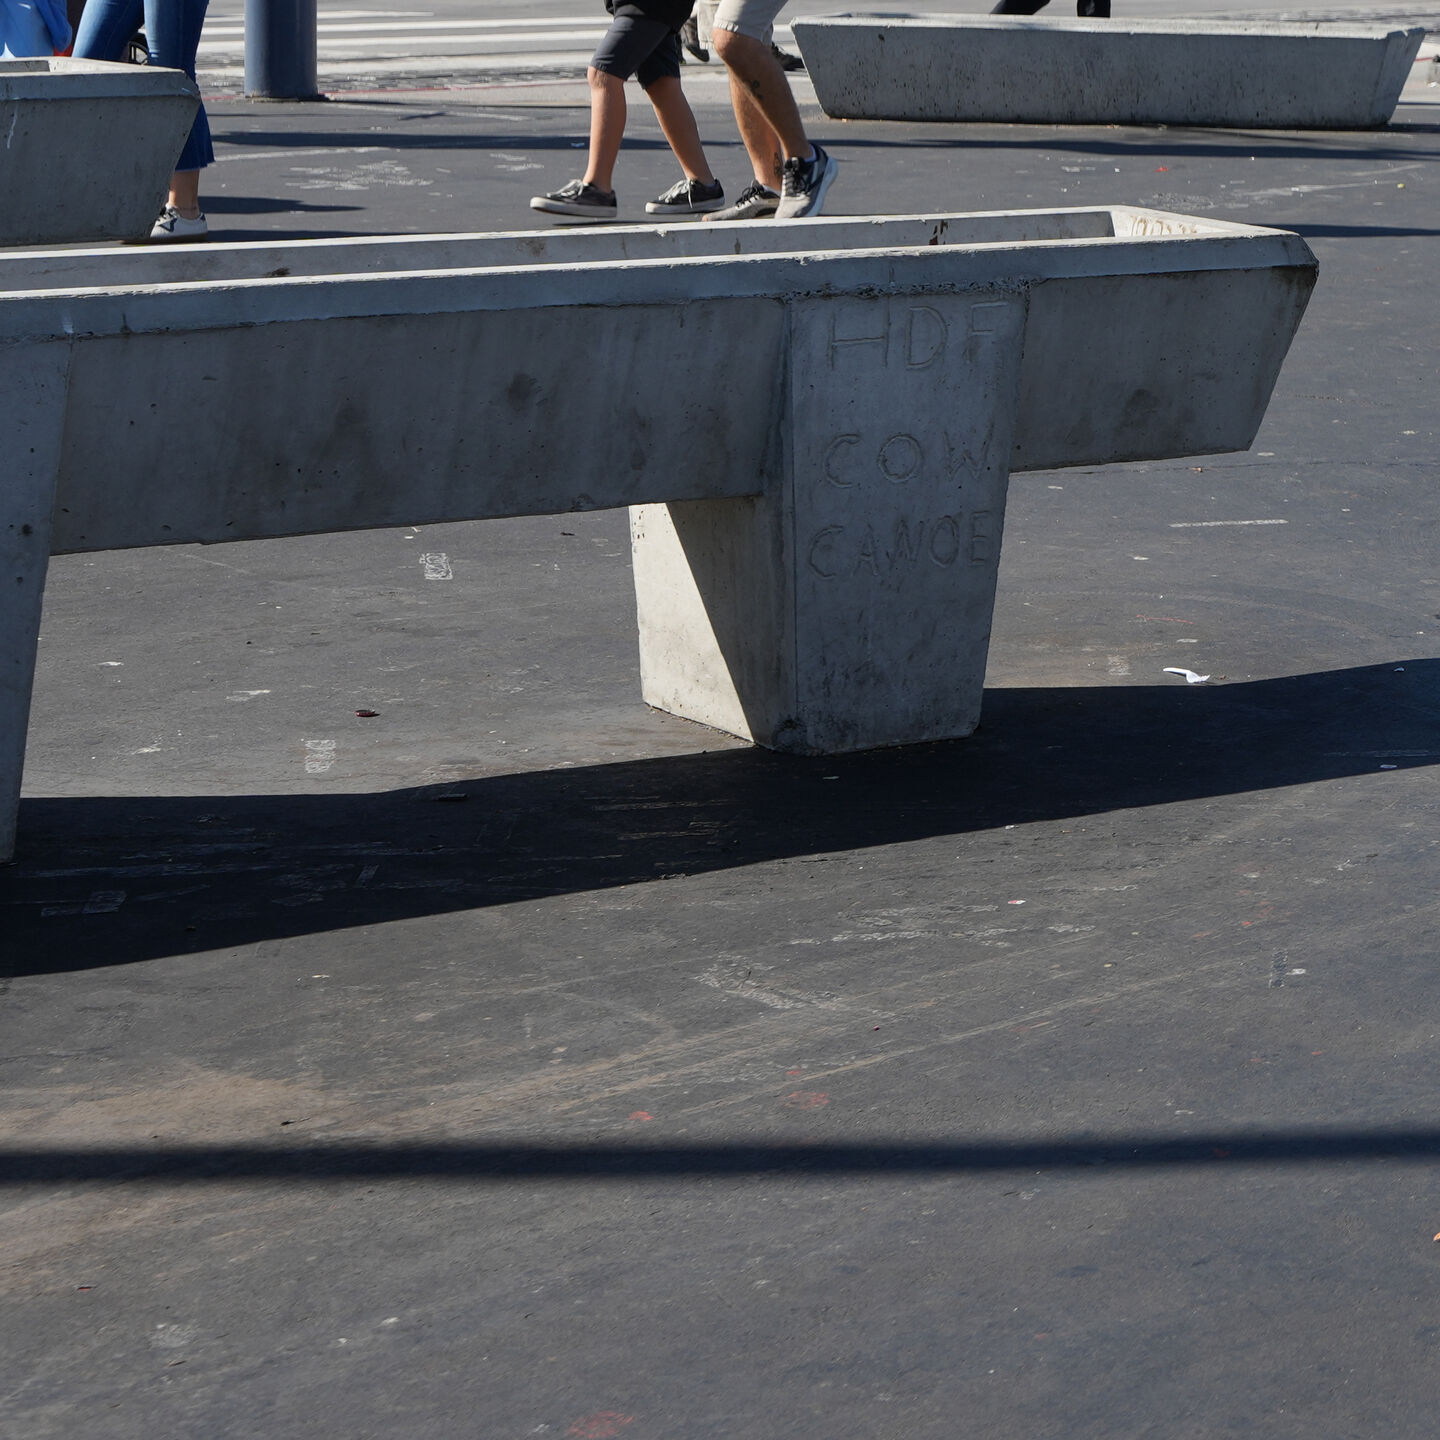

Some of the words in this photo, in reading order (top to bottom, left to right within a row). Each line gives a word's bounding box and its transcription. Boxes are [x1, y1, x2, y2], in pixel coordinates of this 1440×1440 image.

[826, 297, 1009, 371] HDF
[823, 421, 995, 488] COW
[807, 511, 993, 581] CANOE
